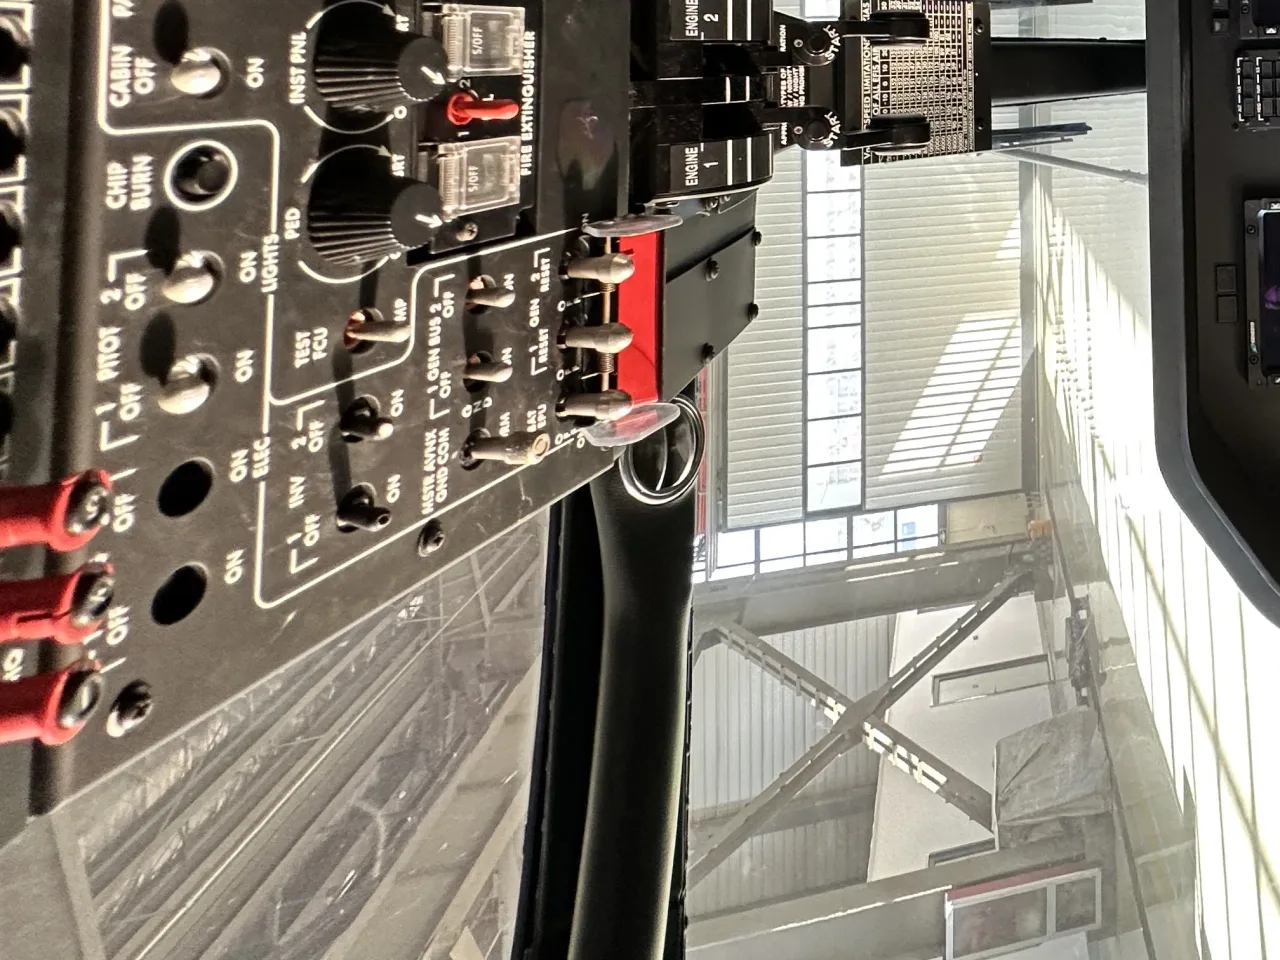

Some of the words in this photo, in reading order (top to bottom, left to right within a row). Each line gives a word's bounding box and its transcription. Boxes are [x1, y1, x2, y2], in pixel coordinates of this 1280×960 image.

[704, 13, 718, 22] 2
[291, 31, 307, 63] PNL
[472, 26, 482, 55] S/OFF
[823, 24, 841, 60] START
[110, 45, 132, 107] CABIN
[135, 57, 156, 94] OFF
[247, 58, 265, 88] ON
[290, 66, 306, 104] INST
[459, 79, 471, 88] 2
[522, 30, 536, 141] EXTINGUISHER
[824, 111, 841, 148] START
[521, 145, 533, 176] FIRE
[685, 147, 699, 186] ENGINE
[107, 162, 127, 209] CHIP
[132, 155, 153, 210] BURN
[468, 165, 479, 193] S/OFF
[285, 208, 300, 239] PED
[240, 251, 257, 282] ON
[262, 234, 279, 293] LIGHTS
[540, 258, 551, 292] RESET
[100, 288, 121, 304] 2
[126, 273, 147, 310] OFF
[432, 302, 442, 313] 2
[443, 291, 455, 318] OFF
[529, 298, 540, 327] GEN
[313, 327, 329, 359] FCU
[429, 316, 442, 345] BUS
[538, 328, 549, 363] RESET
[97, 326, 121, 381] PITOT
[294, 331, 312, 368] TEST
[428, 348, 441, 381] GEN
[236, 350, 254, 383] ON
[440, 372, 452, 398] OFF
[95, 403, 116, 414] 1
[120, 383, 142, 421] OFF
[391, 389, 405, 417] ON
[308, 420, 325, 453] OFF
[528, 410, 538, 432] BAT
[253, 437, 270, 478] ELEC
[292, 436, 307, 449] 2
[424, 429, 438, 471] AVNX
[438, 428, 451, 464] COM
[230, 449, 249, 482] ON
[289, 476, 306, 508] INV
[388, 474, 401, 503] ON
[422, 474, 437, 514] MSTR
[436, 467, 449, 502] GND
[112, 494, 137, 532] OFF
[287, 532, 301, 544] 1
[305, 514, 321, 546] OFF
[225, 550, 245, 584] ON
[107, 606, 130, 644] OFF
